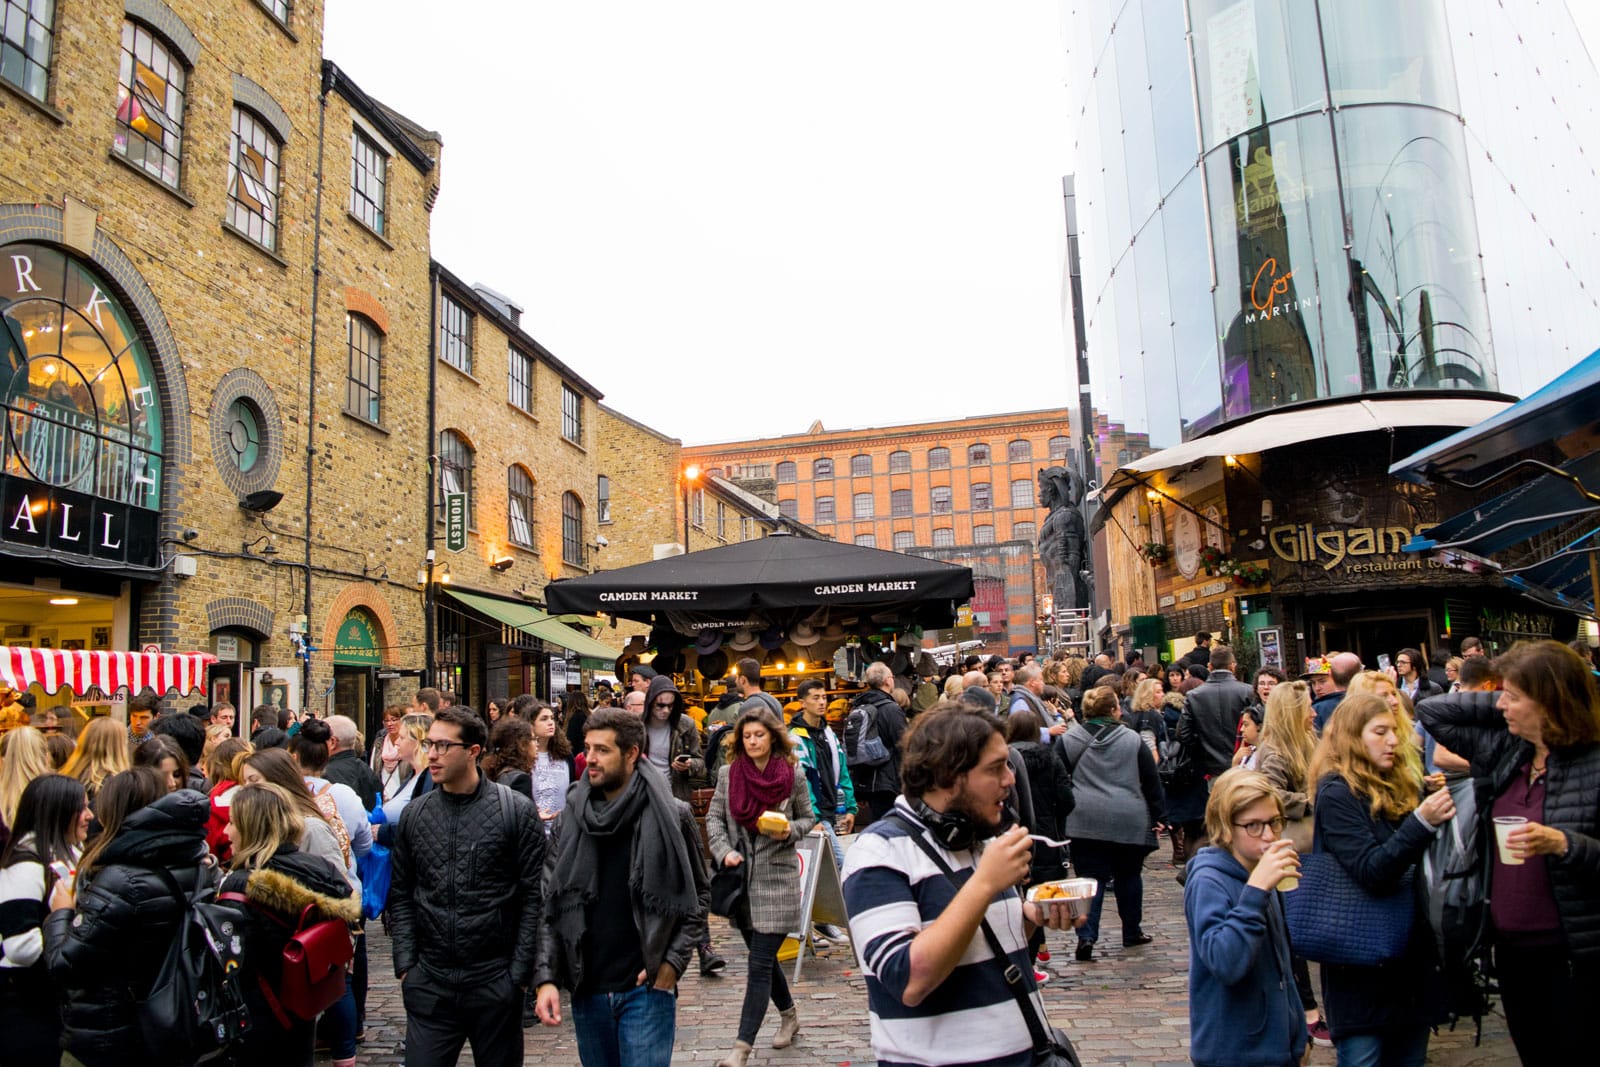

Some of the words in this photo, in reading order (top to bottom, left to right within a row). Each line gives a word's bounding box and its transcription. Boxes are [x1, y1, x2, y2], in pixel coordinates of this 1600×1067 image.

[1245, 295, 1320, 324] MARTINI
[10, 494, 121, 549] ALL
[451, 498, 462, 545] HONEST
[1346, 559, 1422, 574] restaurant
[599, 592, 647, 601] CAMDEN
[651, 591, 699, 600] MARKET
[814, 583, 864, 595] CAMDEN
[867, 581, 917, 592] MARKET
